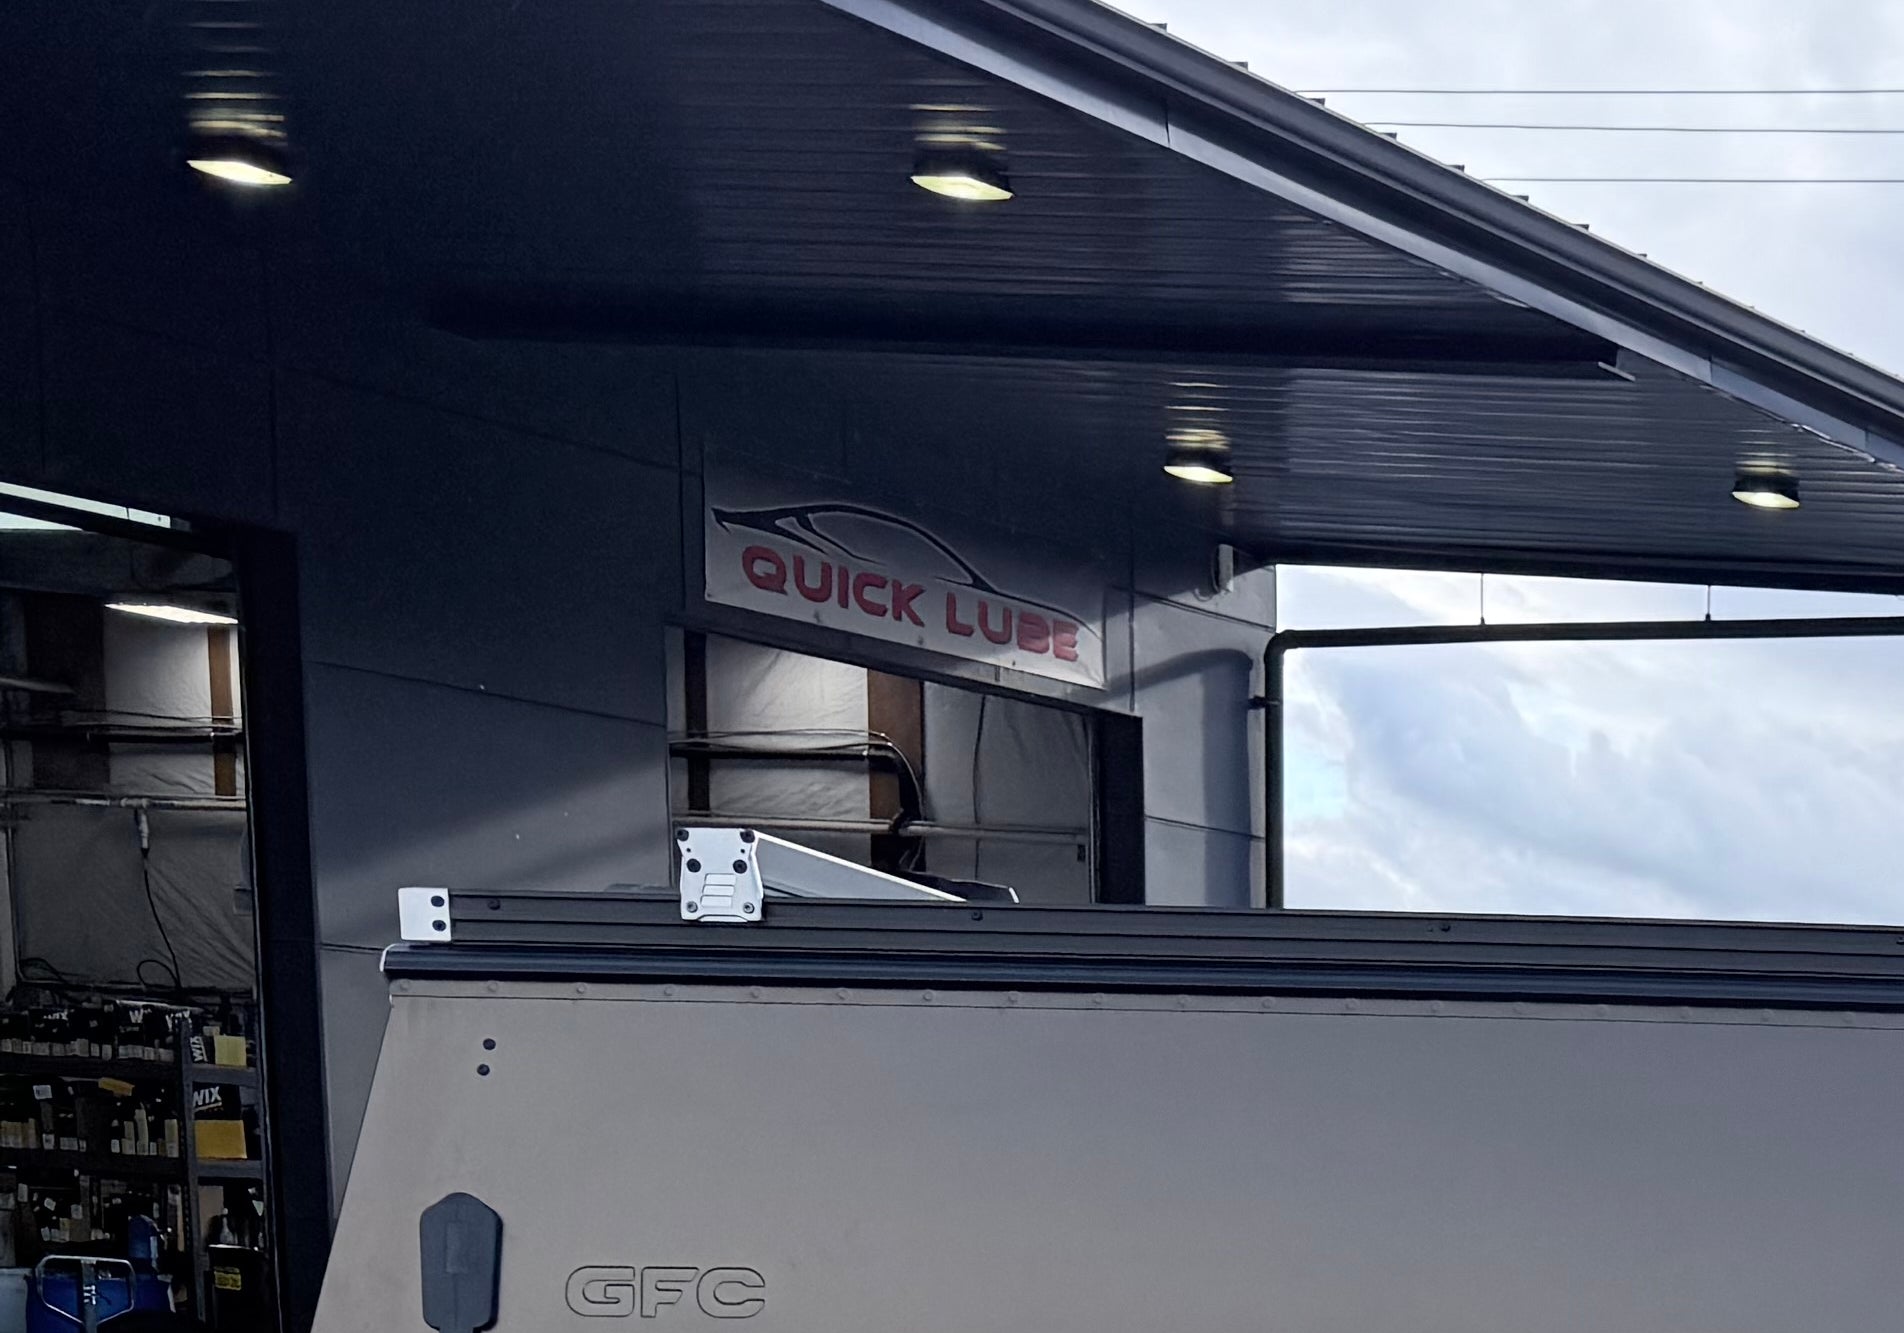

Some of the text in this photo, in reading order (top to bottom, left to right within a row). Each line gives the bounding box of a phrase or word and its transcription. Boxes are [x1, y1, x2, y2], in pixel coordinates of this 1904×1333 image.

[742, 545, 1079, 662] QUICK LUBE
[565, 1265, 766, 1319] GFC
